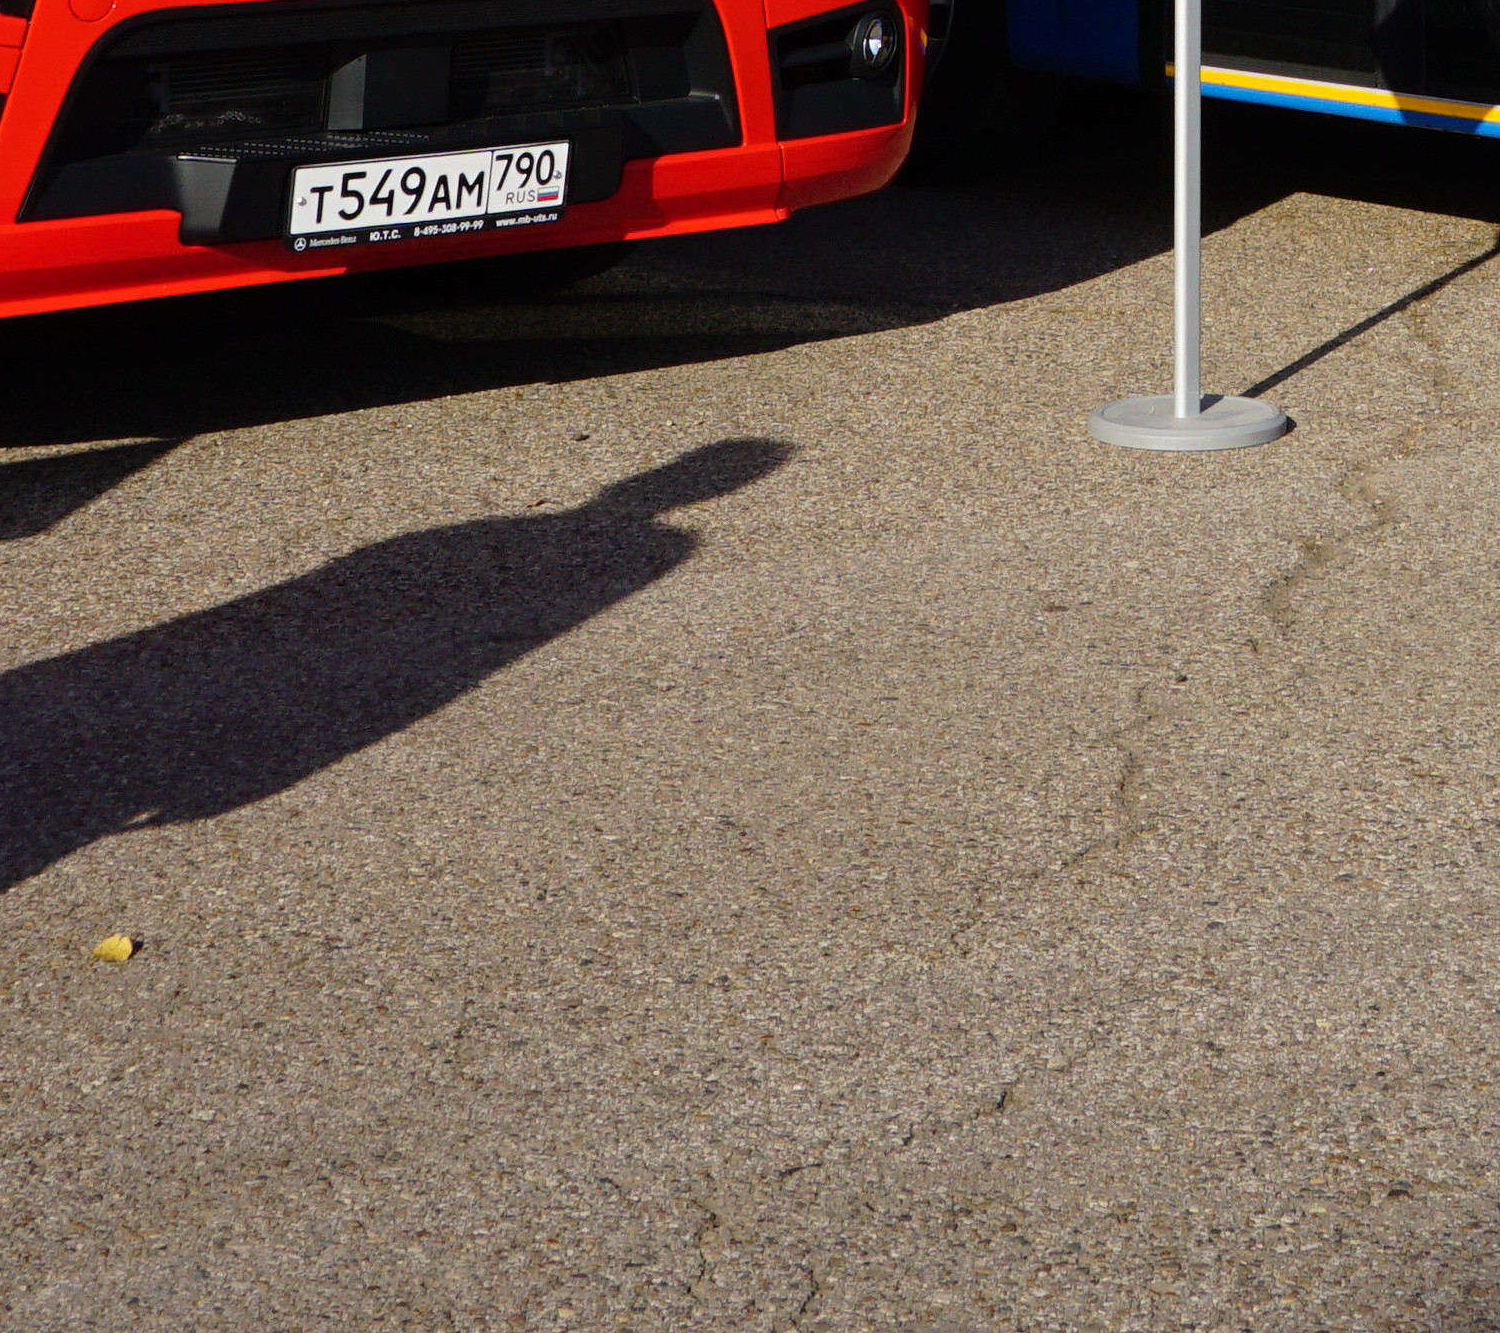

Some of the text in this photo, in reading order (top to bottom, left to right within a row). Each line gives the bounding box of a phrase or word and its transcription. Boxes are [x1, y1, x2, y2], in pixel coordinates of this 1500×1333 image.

[310, 149, 555, 223] Т549АМ 790 RUS
